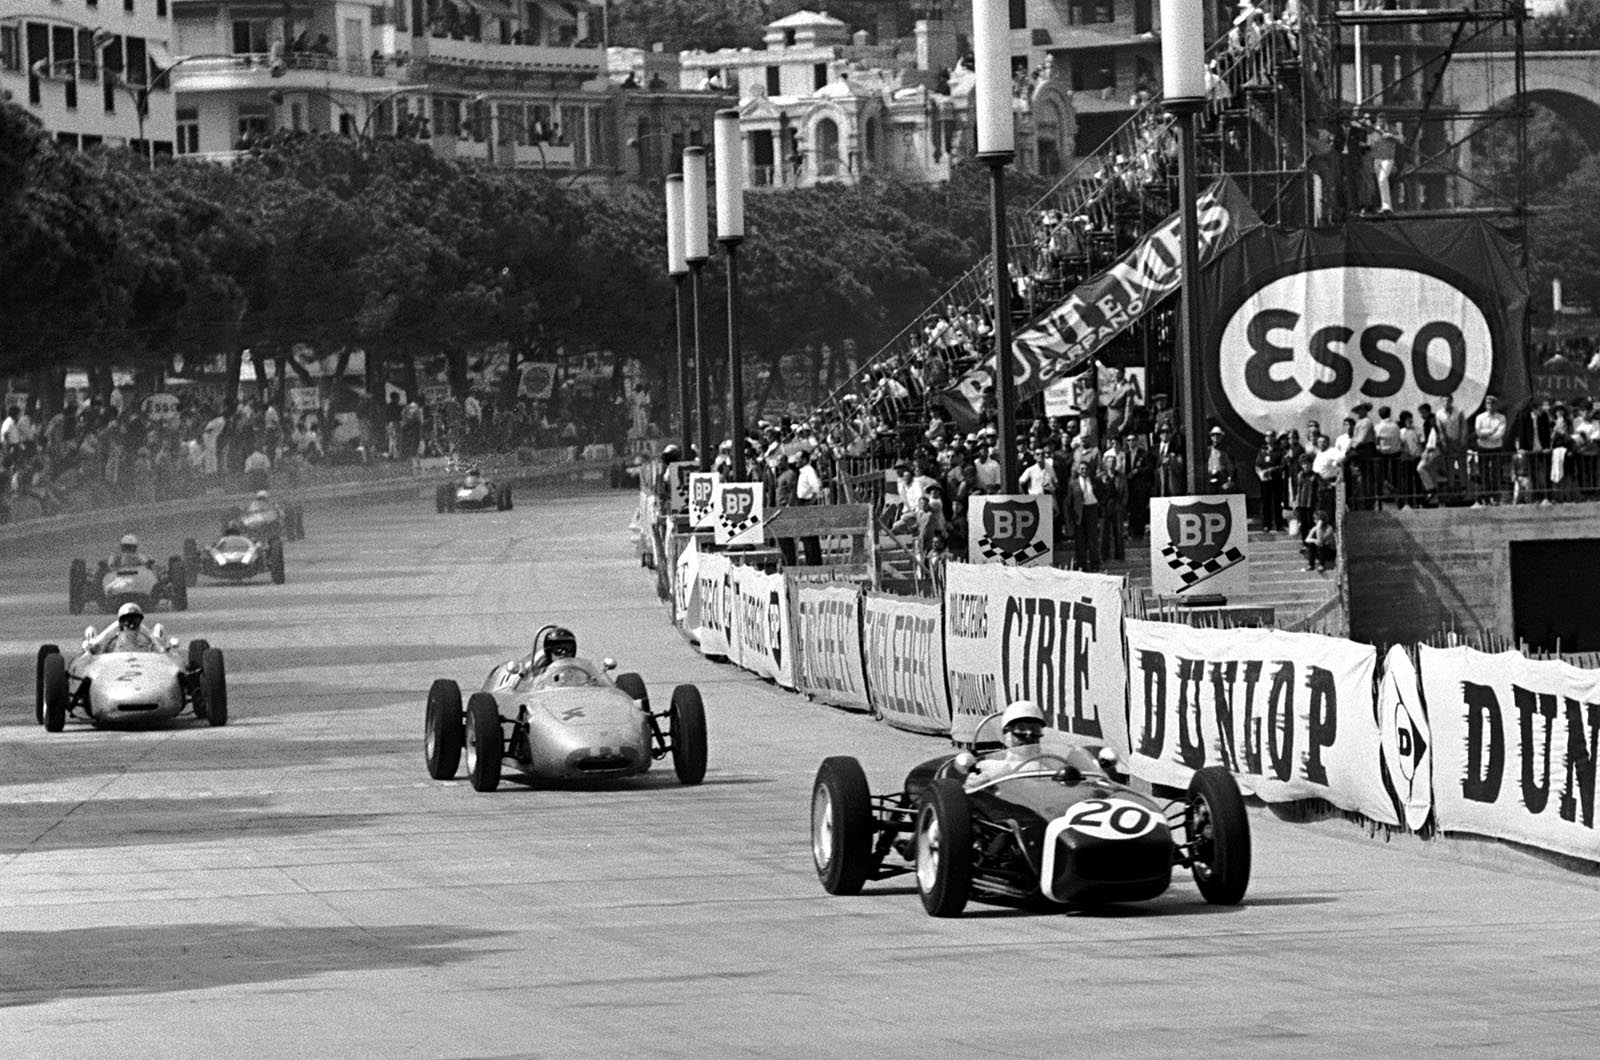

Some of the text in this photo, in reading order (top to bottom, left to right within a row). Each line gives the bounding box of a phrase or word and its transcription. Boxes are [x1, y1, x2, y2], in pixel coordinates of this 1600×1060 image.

[1039, 301, 1143, 380] CARPANO
[696, 482, 711, 500] BP
[726, 493, 751, 514] BP
[992, 510, 1035, 539] BP
[1176, 513, 1226, 546] BP
[1134, 649, 1337, 786] DUNLOP
[1069, 800, 1151, 835] 20
